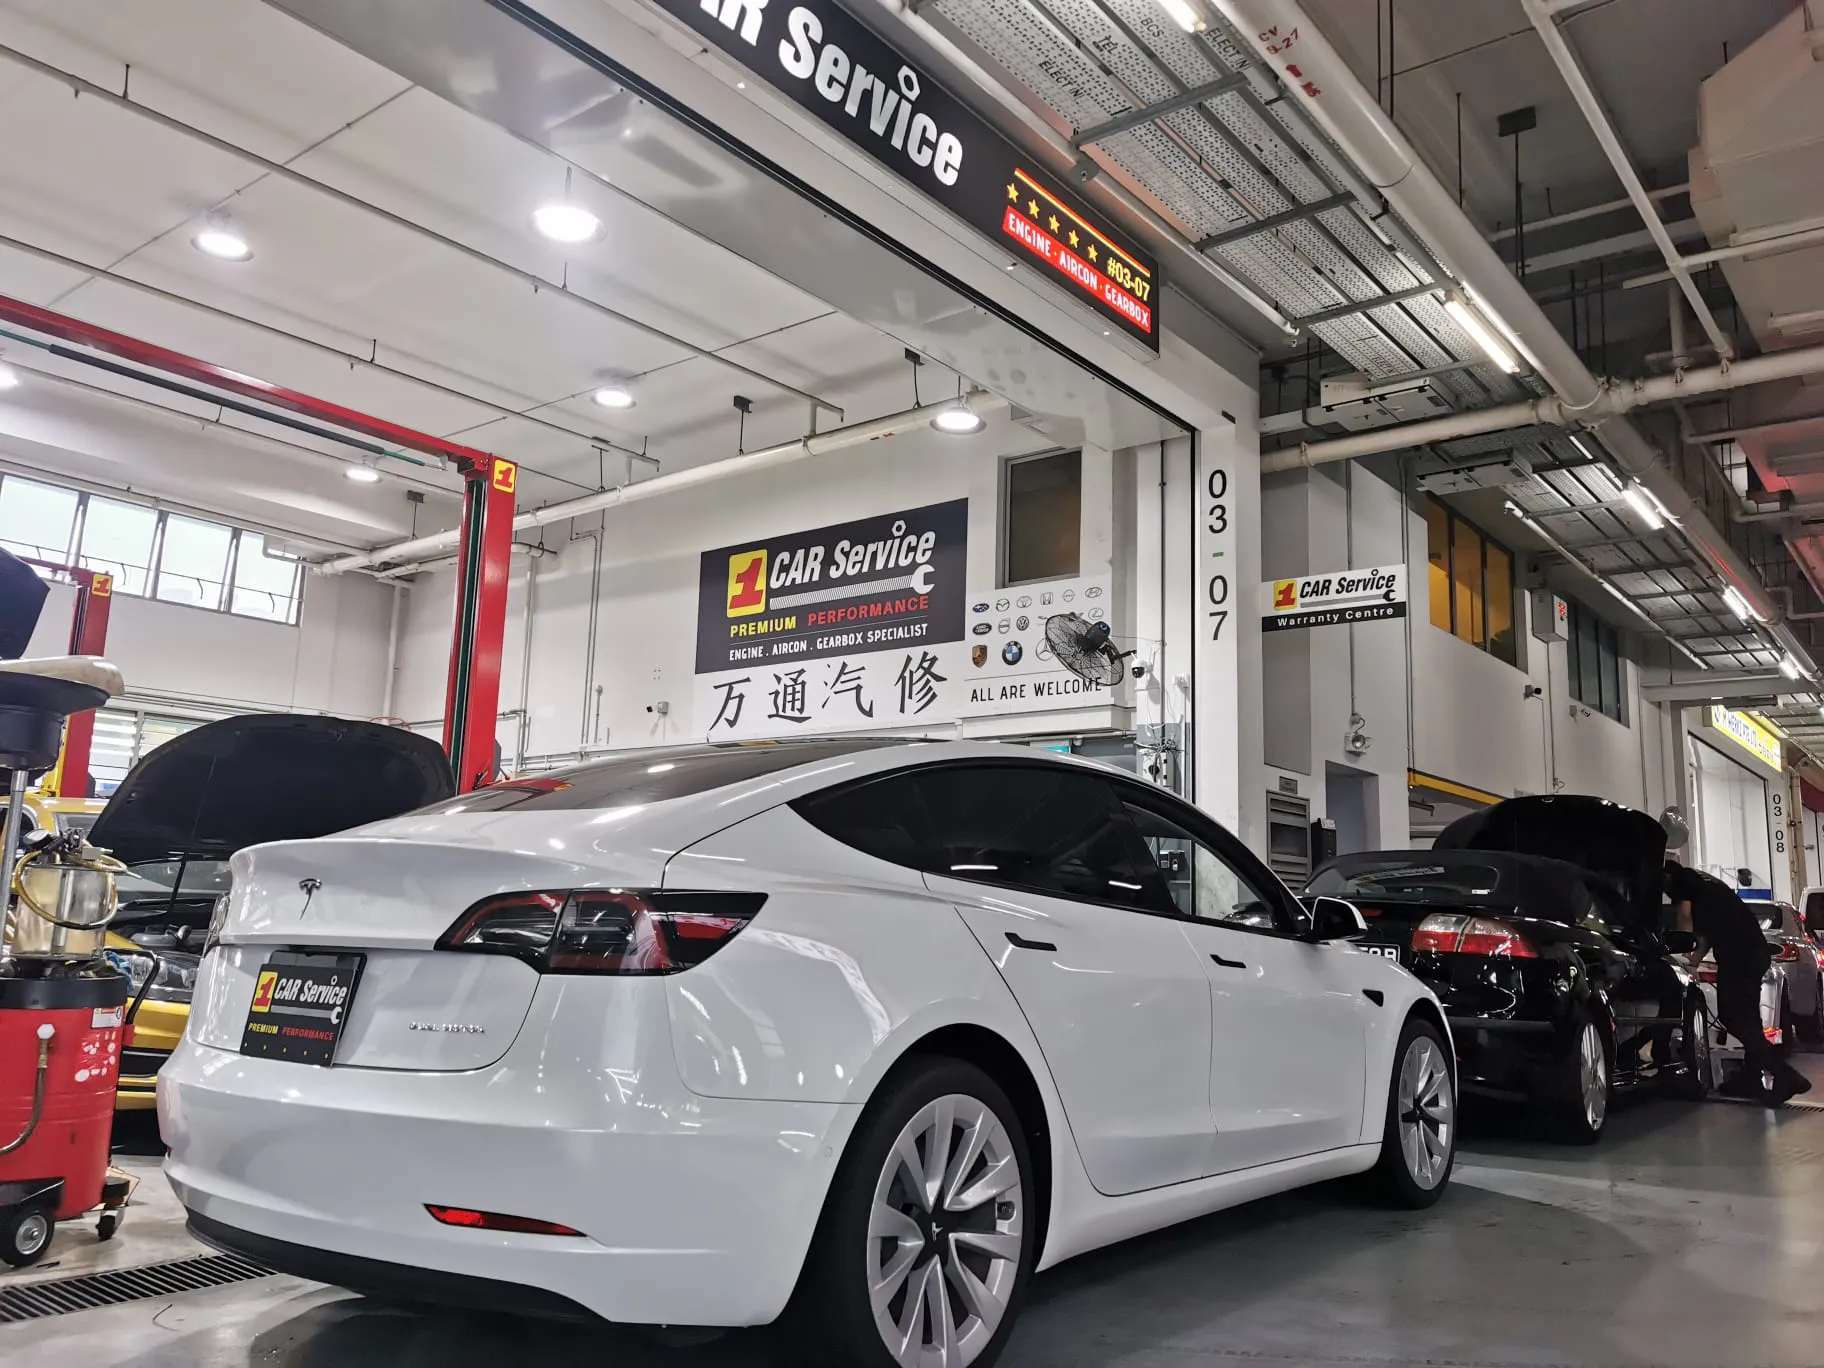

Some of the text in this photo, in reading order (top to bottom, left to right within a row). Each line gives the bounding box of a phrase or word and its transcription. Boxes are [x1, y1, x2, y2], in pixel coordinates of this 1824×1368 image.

[1204, 27, 1241, 57] ELECT
[1258, 26, 1278, 42] CV
[1039, 61, 1073, 87] ELECT
[778, 6, 963, 186] Service
[1008, 213, 1149, 327] ENGINE AIRCON GEARBOX
[1107, 257, 1150, 301] #03-07
[728, 520, 936, 610] 1 CAR Service
[1274, 569, 1396, 608] 1 CAR Service
[730, 595, 929, 638] PREMIUM PERFORMANCE
[1277, 606, 1394, 627] Warranty Centre
[729, 623, 929, 661] ENGINE AIRCON GEARBOX SPECIALIST
[709, 651, 948, 729] 万通汽修
[970, 677, 1103, 702] ALL ARE WELCOME
[254, 975, 348, 1007] 1 CAR Service
[248, 1022, 335, 1041] PREMIUM PERFORMANCE
